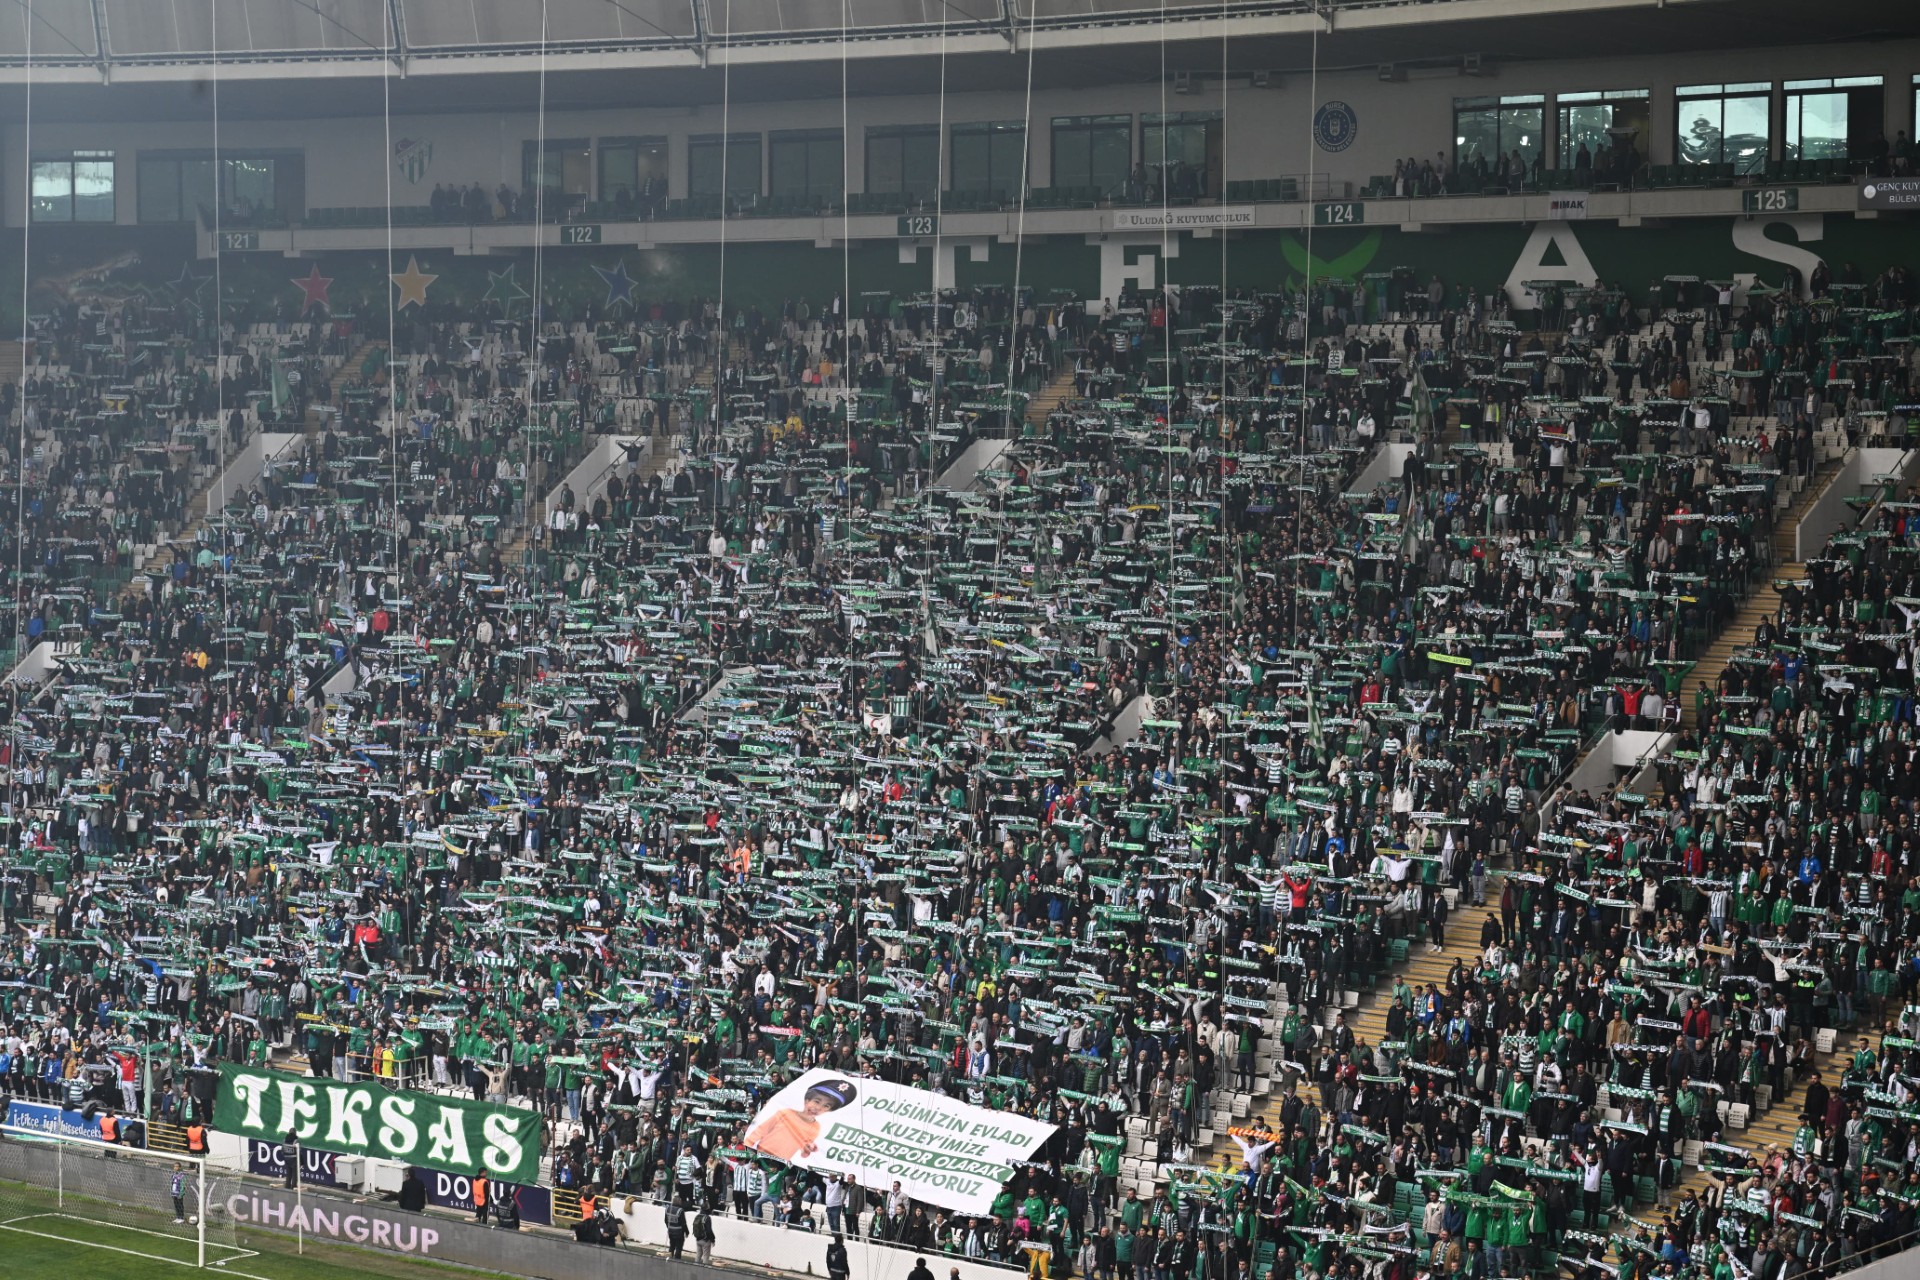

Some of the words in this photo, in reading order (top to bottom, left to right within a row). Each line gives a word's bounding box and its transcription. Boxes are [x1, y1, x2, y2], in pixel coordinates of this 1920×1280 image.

[1876, 182, 1900, 192] GENÇ
[1754, 189, 1787, 210] 125
[1176, 214, 1250, 224] KUYUMCULUK
[1325, 204, 1353, 222] 124
[906, 217, 932, 234] 123
[226, 234, 250, 249] 121
[569, 227, 592, 243] 122
[1617, 792, 1644, 801] BURSASPOR
[1641, 1019, 1674, 1029] BURSASPOR
[44, 1115, 57, 1134] iyi
[233, 1074, 522, 1173] TEKSAS
[862, 1096, 969, 1133] POLİSİMİZİN
[970, 1123, 1033, 1148] EVLADI
[258, 1142, 331, 1174] DOUK
[834, 1126, 934, 1164] BURSASPOR
[934, 1153, 1006, 1181] OLARAK
[826, 1146, 887, 1169] DESTEK
[887, 1163, 984, 1197] OLUYORUZ
[1538, 1168, 1570, 1179] BURSASPOR
